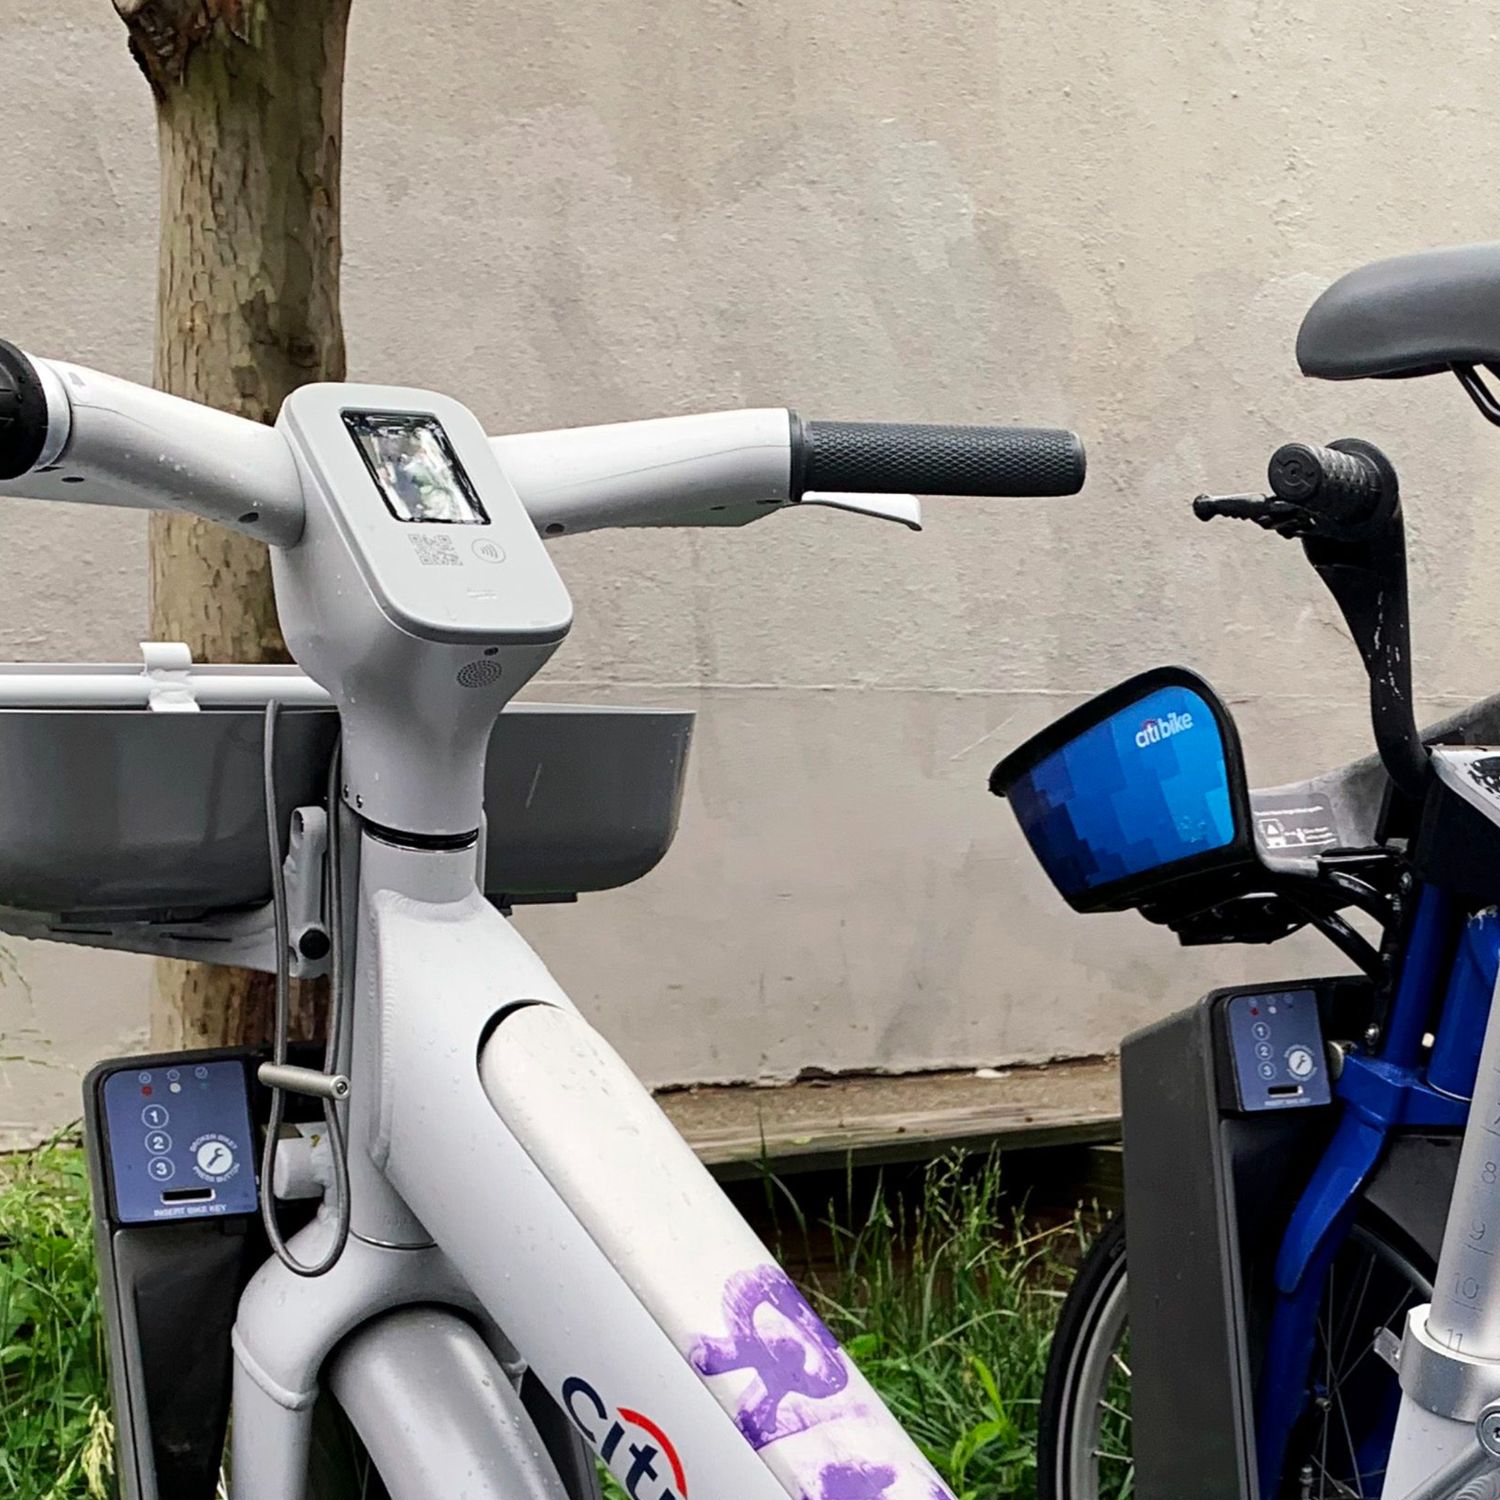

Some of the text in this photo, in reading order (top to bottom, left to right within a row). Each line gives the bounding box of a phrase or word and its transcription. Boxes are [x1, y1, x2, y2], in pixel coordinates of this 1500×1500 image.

[1135, 712, 1194, 748] citi bike
[153, 1136, 165, 1150] 2
[156, 1162, 168, 1176] 3
[1481, 1161, 1497, 1185] 8
[209, 1203, 228, 1213] KEY
[1469, 1221, 1486, 1241] 9
[1453, 1271, 1480, 1300] 10
